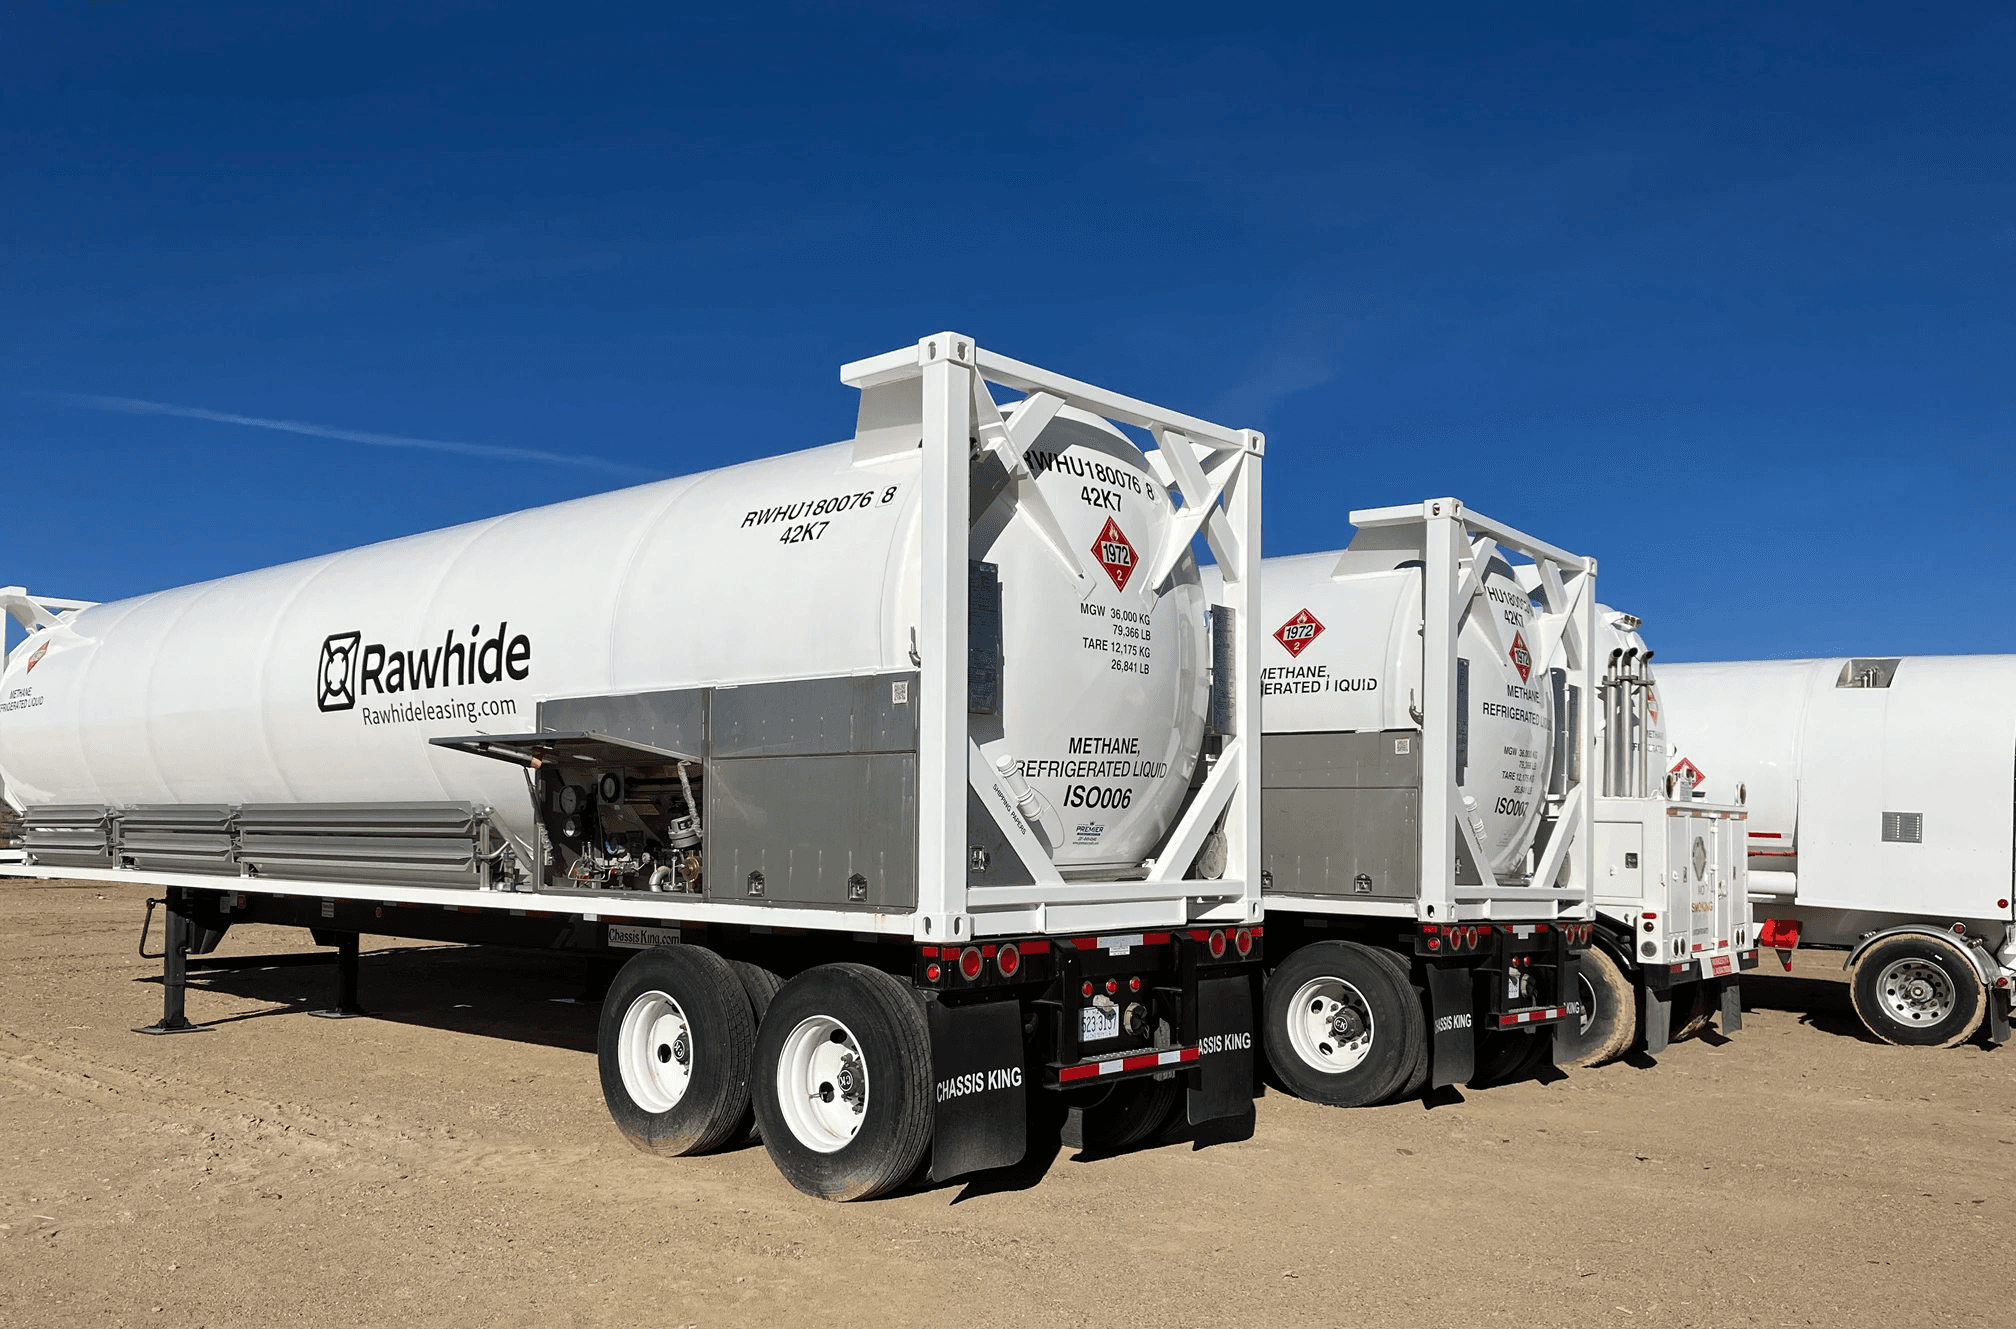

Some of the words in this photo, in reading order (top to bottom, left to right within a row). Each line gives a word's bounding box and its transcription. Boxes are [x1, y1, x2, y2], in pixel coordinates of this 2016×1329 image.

[1081, 486, 1122, 512] 42K7
[1145, 482, 1155, 501] 8
[741, 490, 874, 528] RWHU180076
[881, 486, 898, 504] 8
[780, 521, 830, 545] 42K7
[1103, 543, 1130, 565] 1972
[1117, 569, 1123, 581] 2
[1080, 602, 1106, 617] MGW
[1110, 607, 1138, 623] 36,000
[1139, 613, 1151, 626] KG
[1504, 609, 1524, 628] 42K7
[1112, 624, 1139, 639] 79,366
[1141, 629, 1151, 641] LB
[1285, 624, 1314, 640] 1972
[1082, 636, 1108, 651] TARE
[1111, 641, 1137, 656] 12,175
[1139, 645, 1151, 658] KG
[1293, 641, 1300, 651] 2
[361, 621, 531, 696] Rawhide
[1111, 658, 1137, 673] 26,841
[1140, 662, 1150, 675] LB
[1515, 649, 1529, 666] 1972
[1522, 668, 1527, 677] 2
[362, 698, 517, 725] Rawhideleasing.com
[1482, 702, 1540, 726] REFRIGERATED
[1069, 737, 1141, 757] METHANE,
[1504, 745, 1518, 756] MGW
[1017, 760, 1131, 778] REFRIGERATED
[1133, 761, 1168, 779] LIQUID
[1502, 770, 1516, 781] TARE
[1063, 784, 1133, 809] ISO006
[1494, 796, 1530, 817] ISO007
[992, 783, 1012, 812] SHIPPING
[1011, 811, 1027, 836] PAPERS
[1453, 1013, 1472, 1029] KING
[1198, 1035, 1222, 1056] ASSIS
[1224, 1032, 1251, 1051] KING
[936, 1072, 985, 1103] CHASSIS
[987, 1066, 1022, 1091] KING
